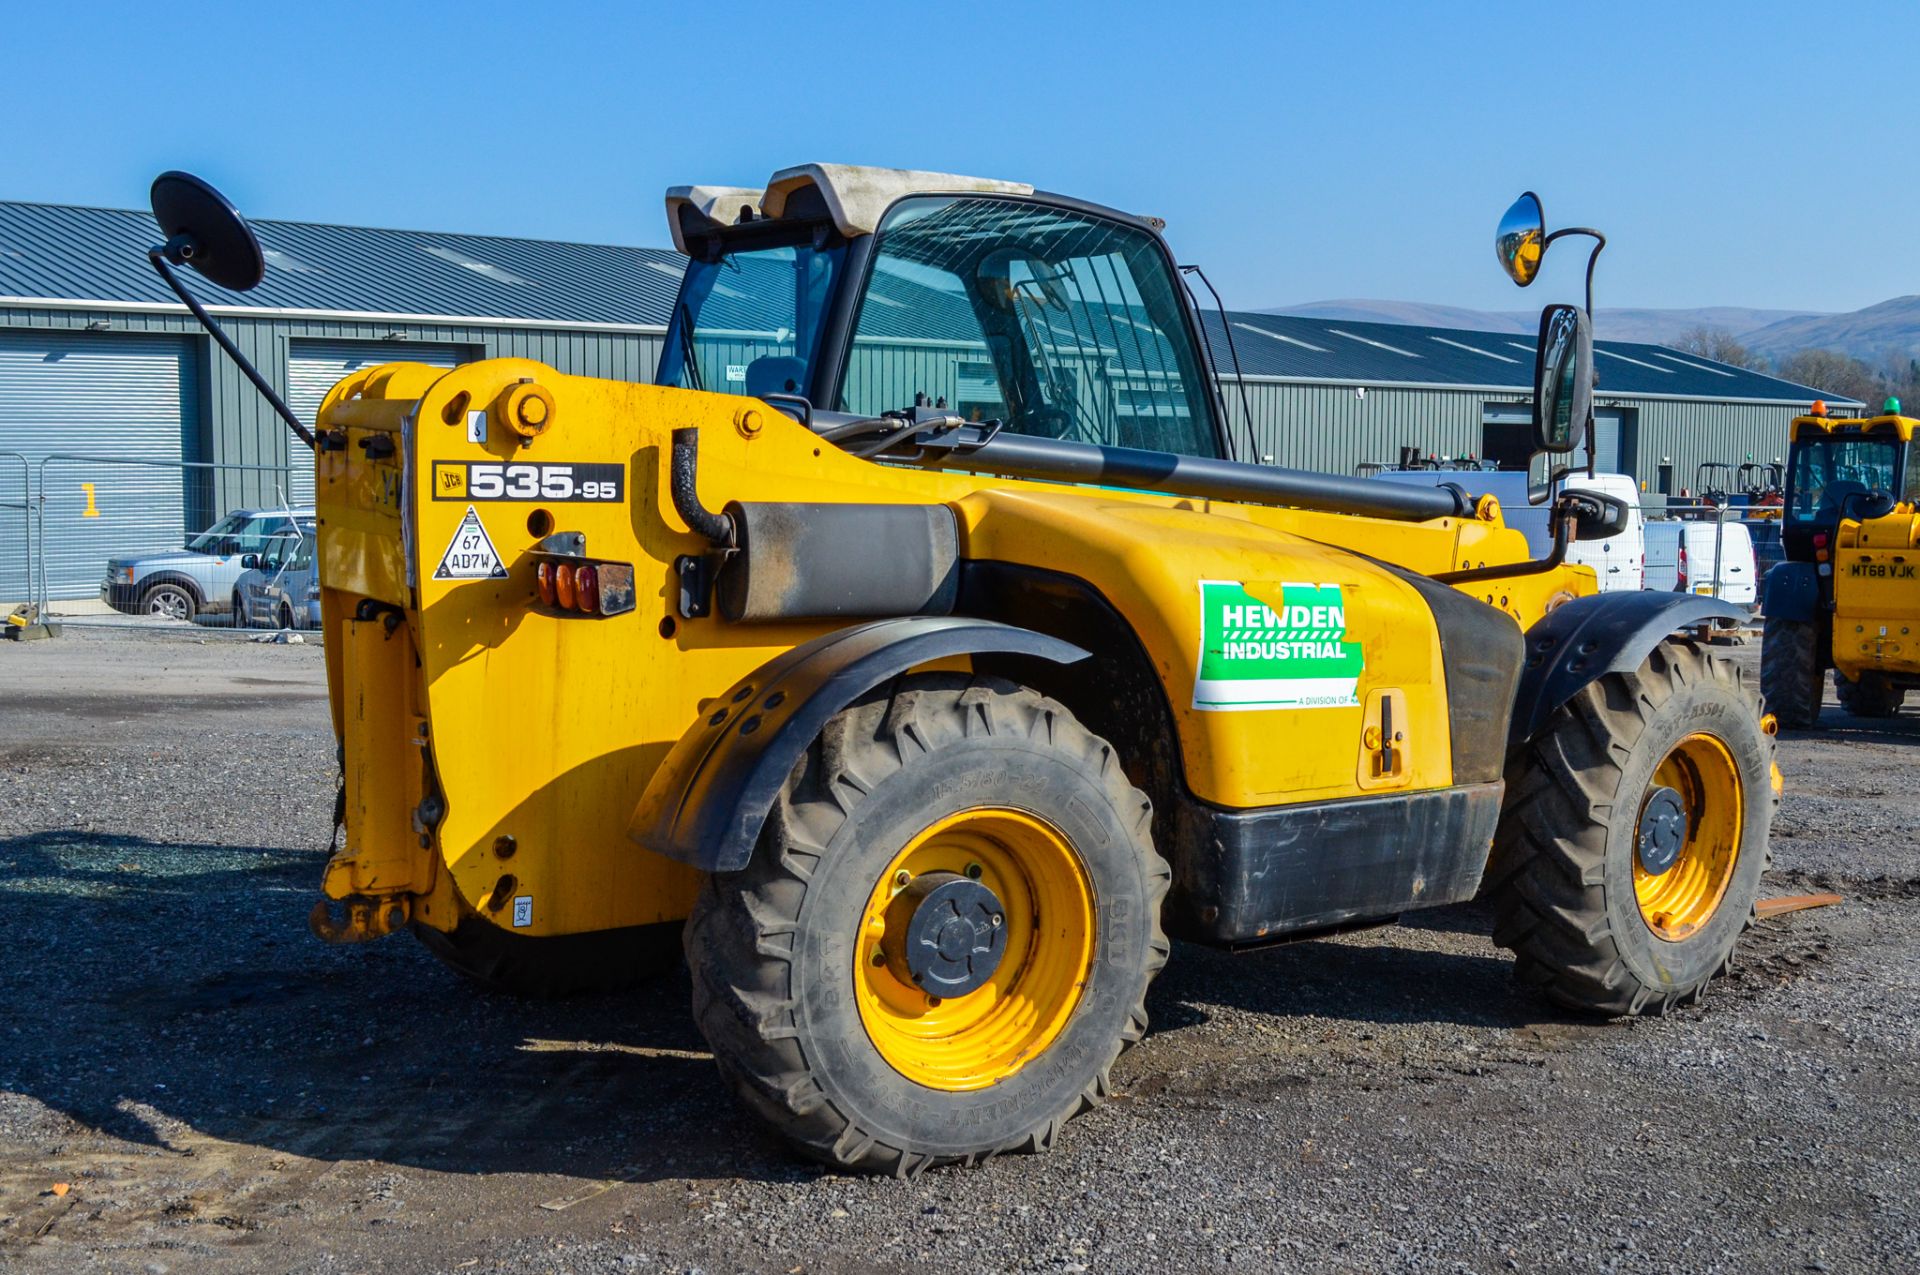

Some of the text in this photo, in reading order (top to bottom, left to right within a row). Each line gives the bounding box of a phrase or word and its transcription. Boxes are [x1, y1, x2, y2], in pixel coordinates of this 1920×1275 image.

[444, 473, 461, 488] JCB
[81, 483, 100, 517] 1
[462, 535, 481, 550] 67
[452, 554, 490, 568] AD7W
[1852, 564, 1915, 578] MT68 VJK
[1222, 604, 1345, 628] HEWDEN
[1223, 641, 1347, 660] INDUSTRIAL
[1298, 697, 1304, 705] A
[1305, 696, 1337, 705] DIVISION
[1338, 695, 1348, 704] OF
